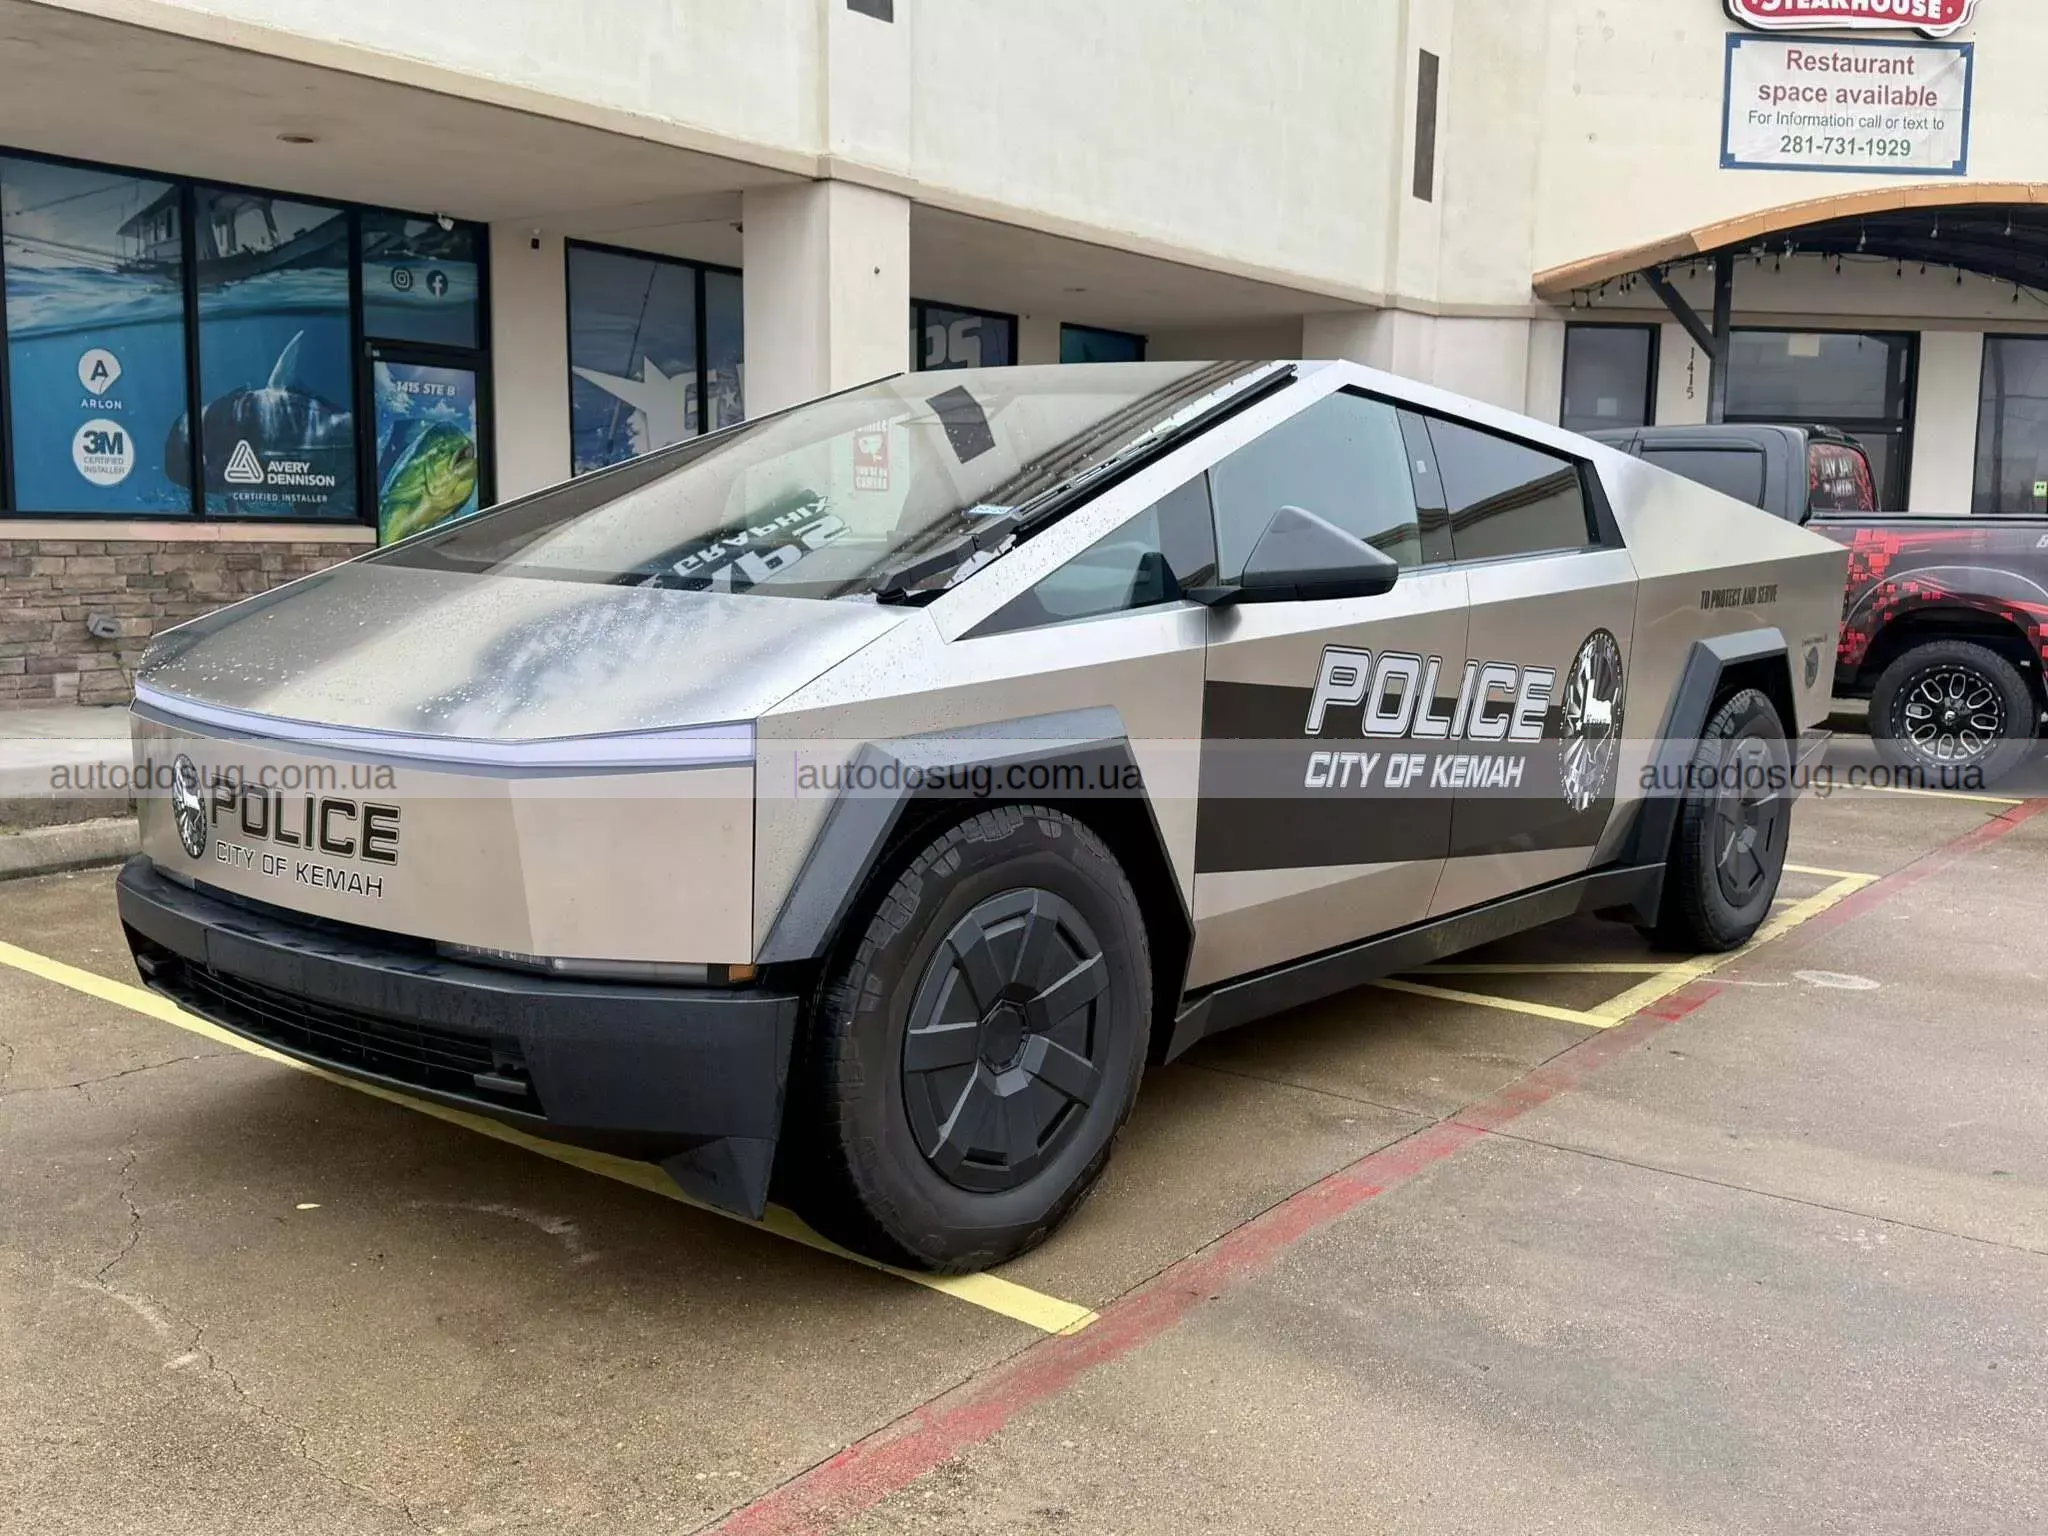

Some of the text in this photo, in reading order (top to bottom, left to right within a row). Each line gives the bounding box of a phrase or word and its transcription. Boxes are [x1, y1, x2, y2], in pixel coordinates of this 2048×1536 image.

[1787, 49, 1915, 75] Restaurant
[1758, 84, 1938, 107] space available
[1748, 110, 1945, 131] For Information call or text to
[1780, 135, 1912, 156] 281-731-1929
[423, 383, 444, 396] STE
[81, 399, 122, 410] ARLON
[82, 430, 124, 456] 3M
[83, 456, 124, 465] CERTIFIED
[84, 465, 126, 475] INSTALLER
[267, 461, 311, 474] AVERY
[267, 473, 336, 487] DENNISON
[233, 492, 328, 503] CERTIFIED INSTALLER
[1700, 589, 1711, 610] TO
[1711, 588, 1742, 609] PROTECT
[1741, 586, 1757, 606] AND
[1304, 644, 1557, 743] POLICE
[1304, 751, 1527, 788] CITY OF KEMAH
[211, 774, 401, 866] POLICE
[216, 840, 383, 899] CITY OF KEMAH
